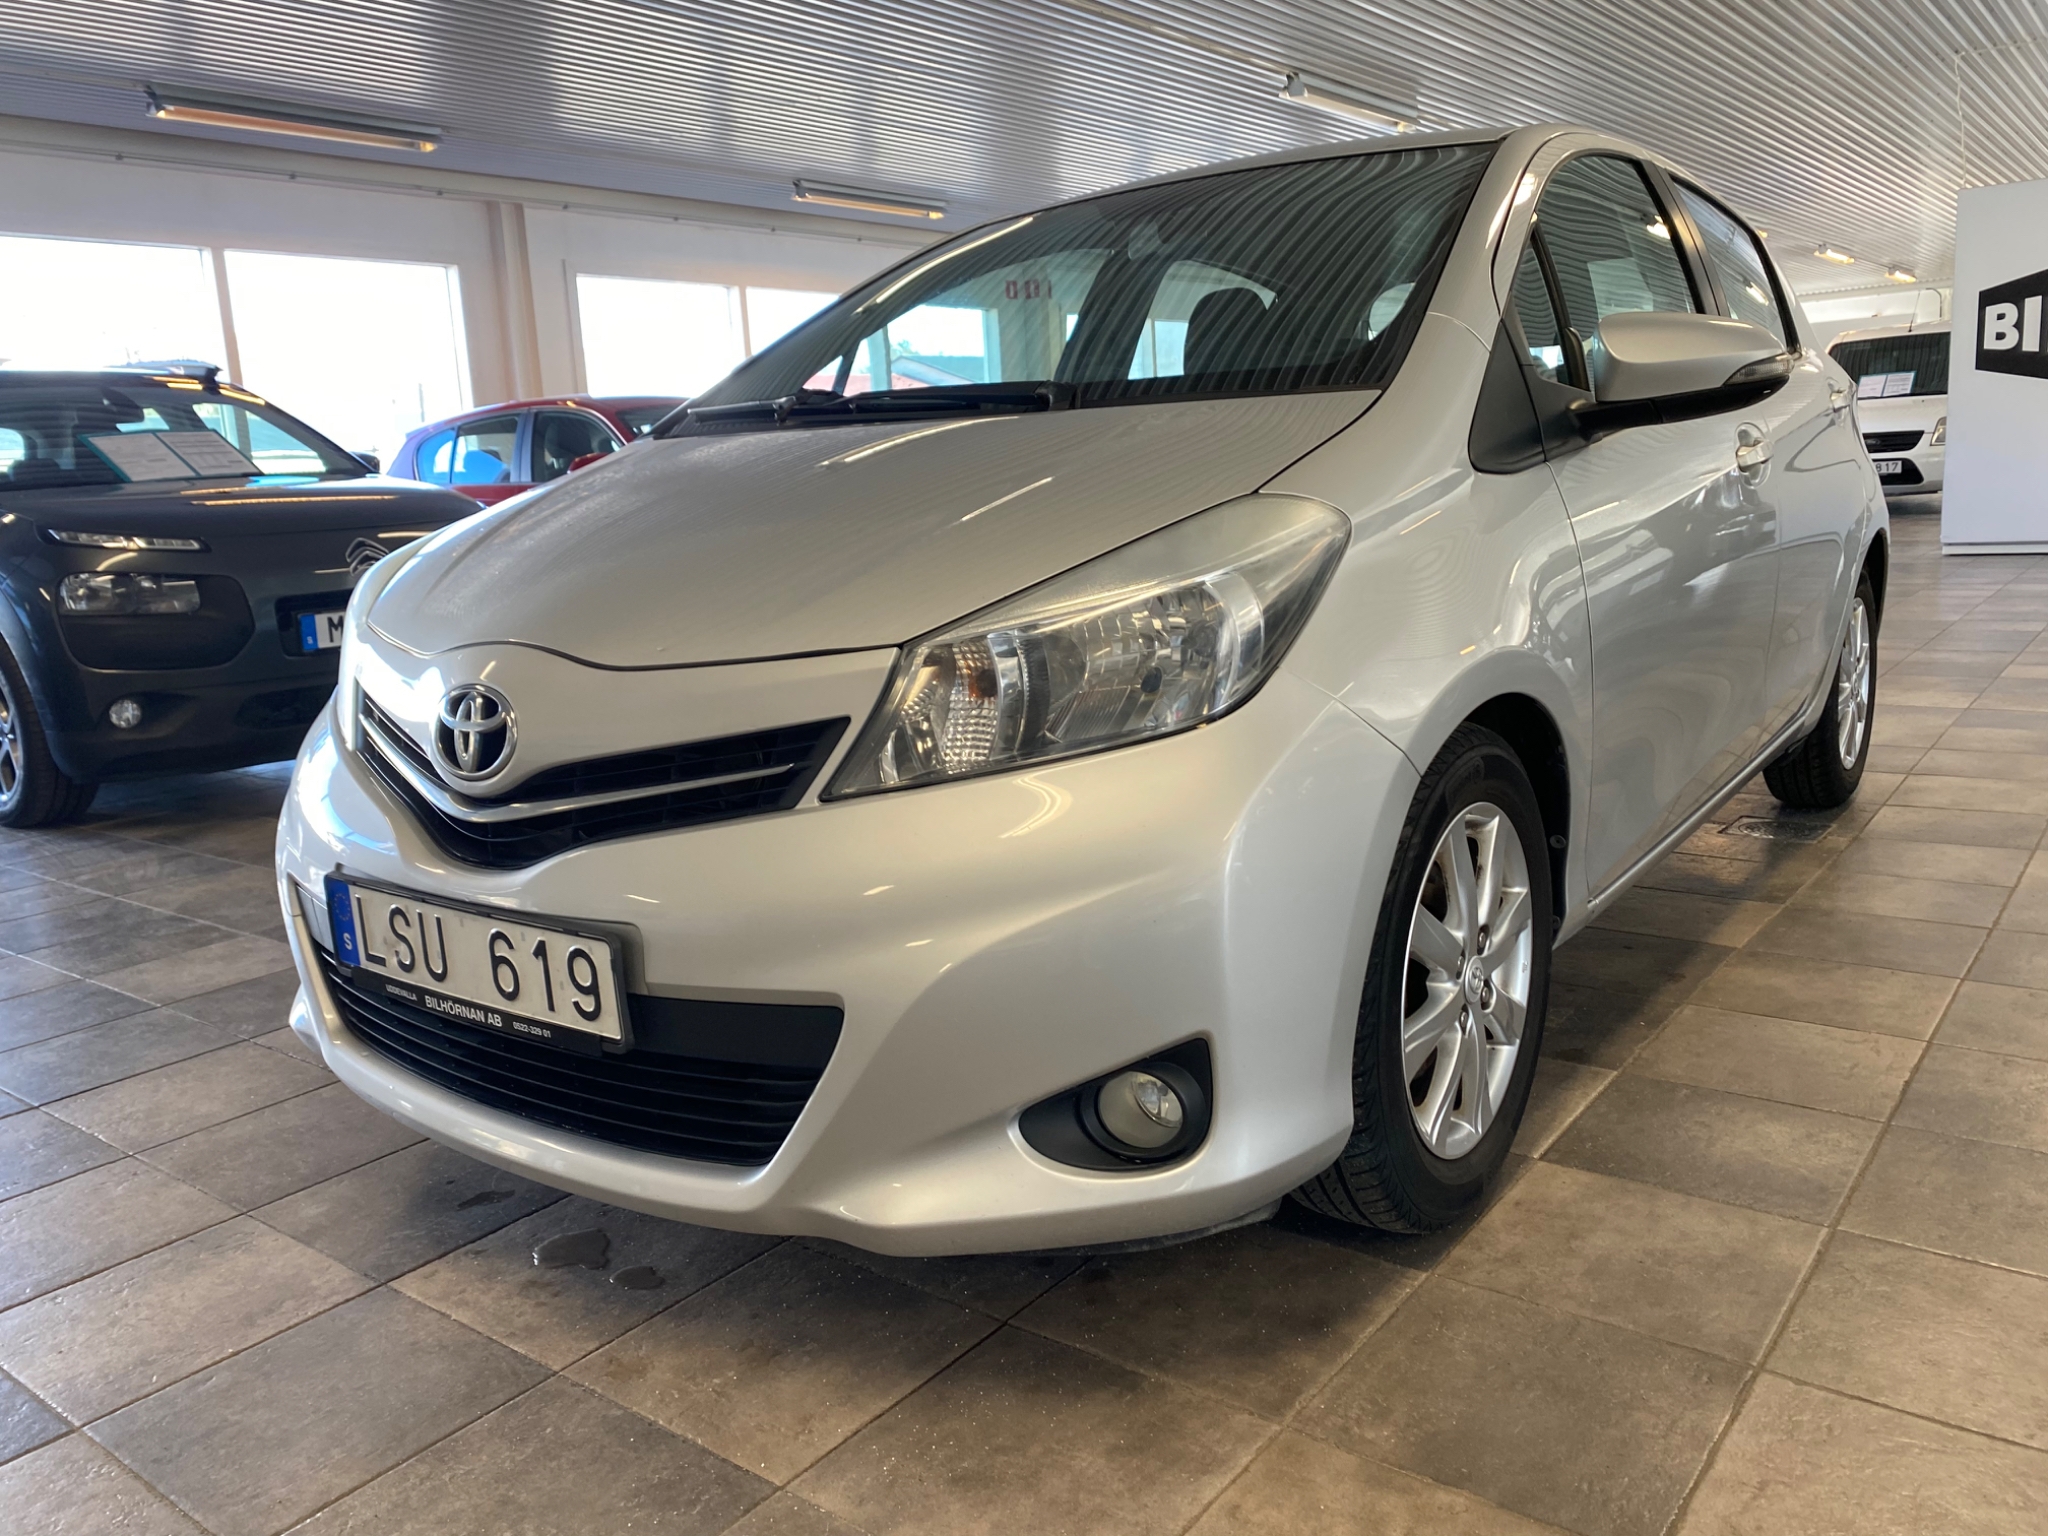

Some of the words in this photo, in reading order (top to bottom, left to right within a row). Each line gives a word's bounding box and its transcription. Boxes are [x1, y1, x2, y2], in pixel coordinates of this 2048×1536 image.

[1983, 294, 2048, 352] BI
[344, 932, 353, 950] S
[355, 893, 448, 982] LSU
[488, 928, 602, 1022] 619
[424, 995, 485, 1023] BILHÖRNAN
[487, 1013, 503, 1027] AB
[512, 1021, 542, 1036] 0522-329
